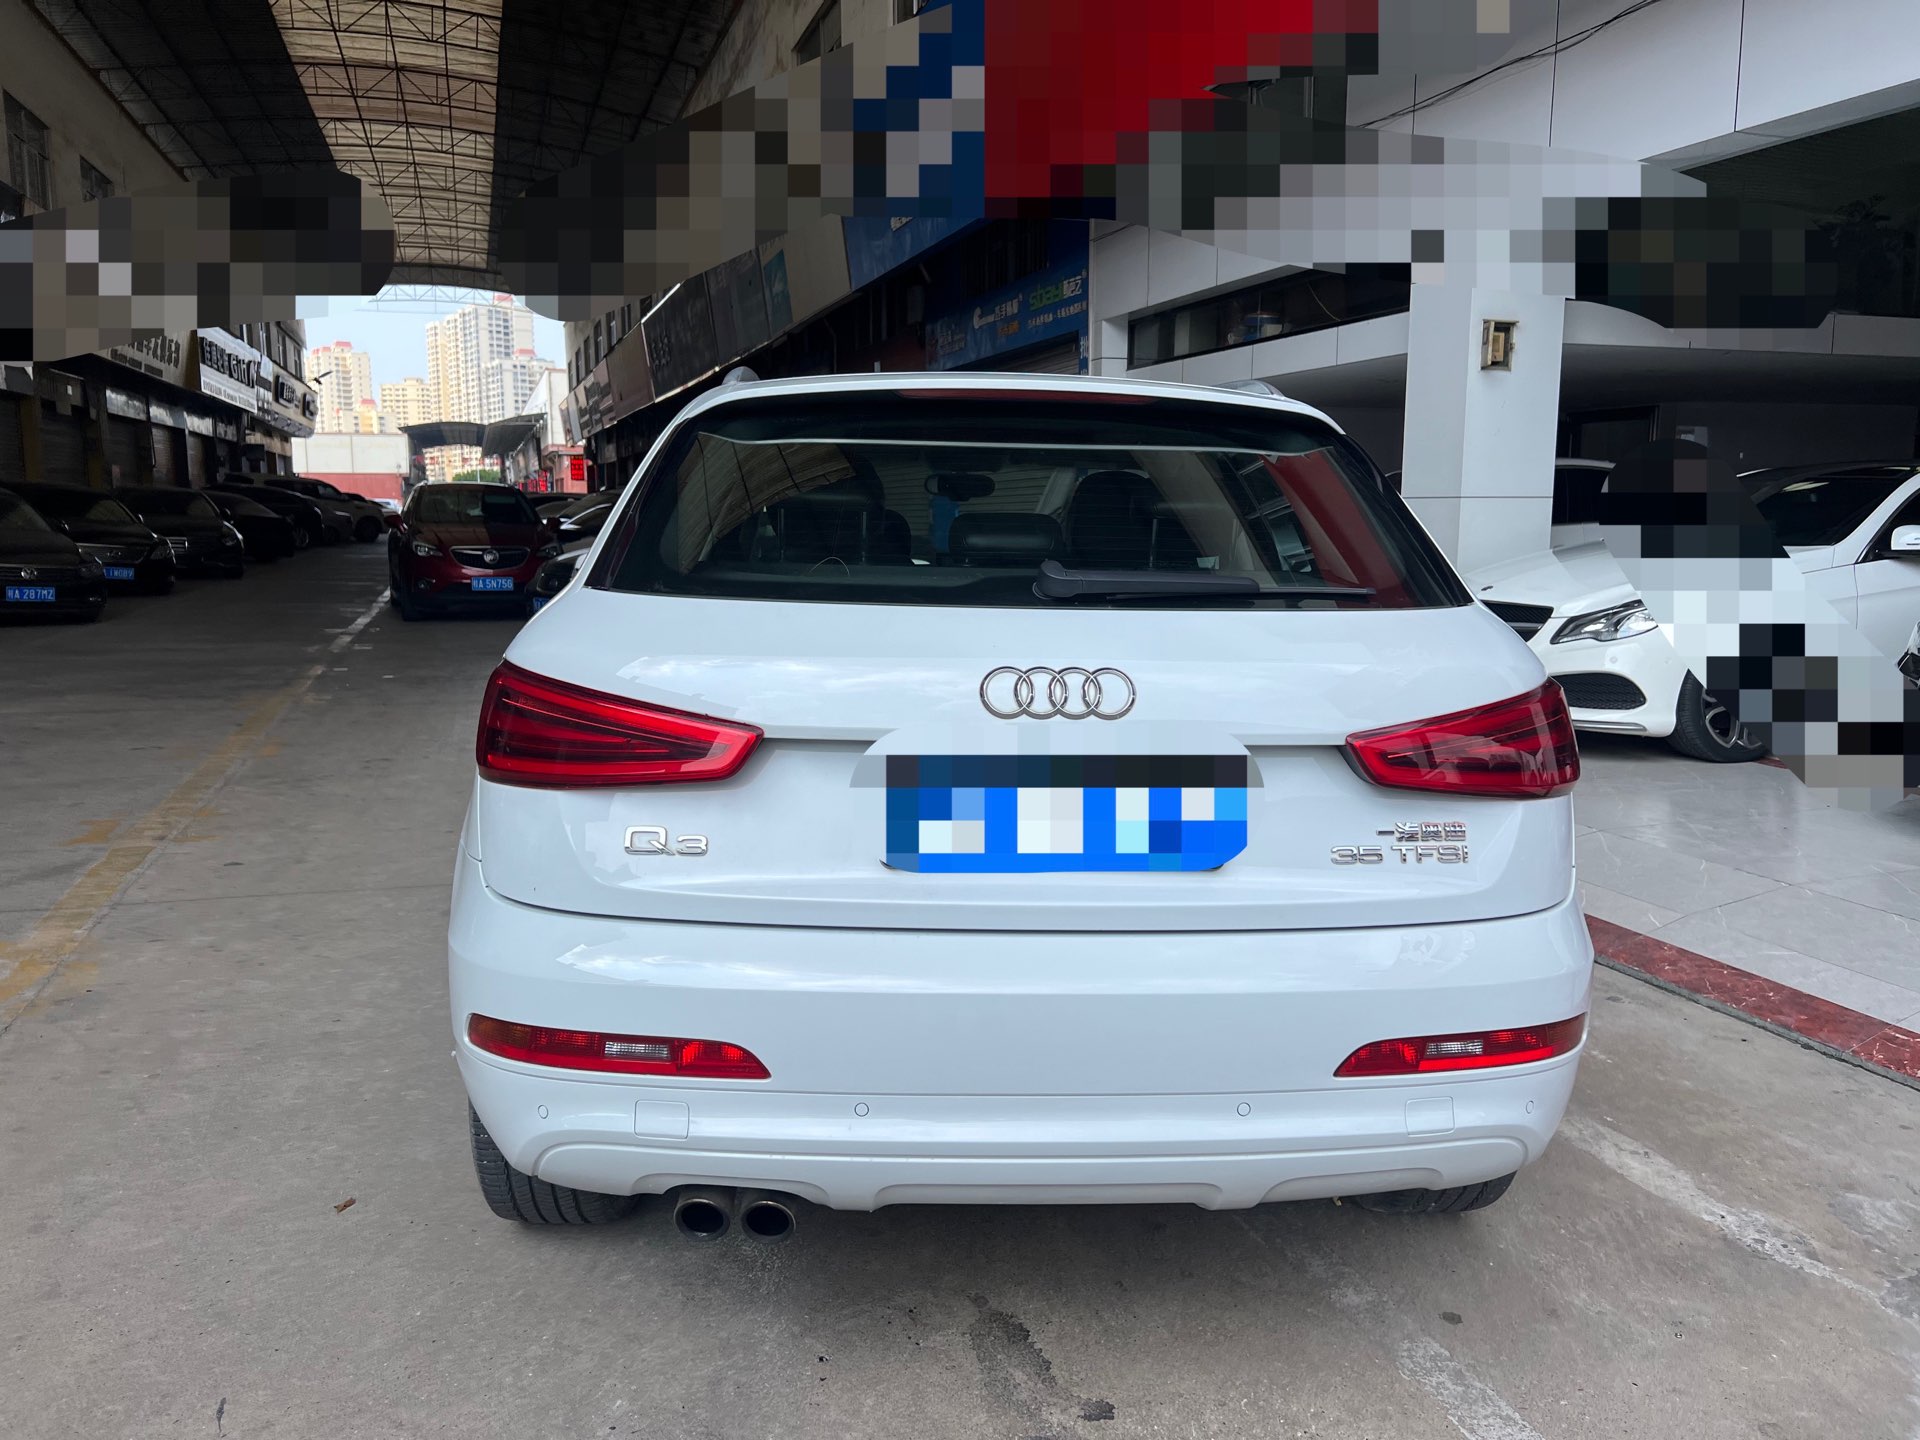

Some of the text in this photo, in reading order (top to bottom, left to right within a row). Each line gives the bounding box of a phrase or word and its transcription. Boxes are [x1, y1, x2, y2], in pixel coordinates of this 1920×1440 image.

[624, 825, 708, 856] Q3
[1376, 822, 1467, 842] 一汽奥迪
[1331, 845, 1384, 865] 35
